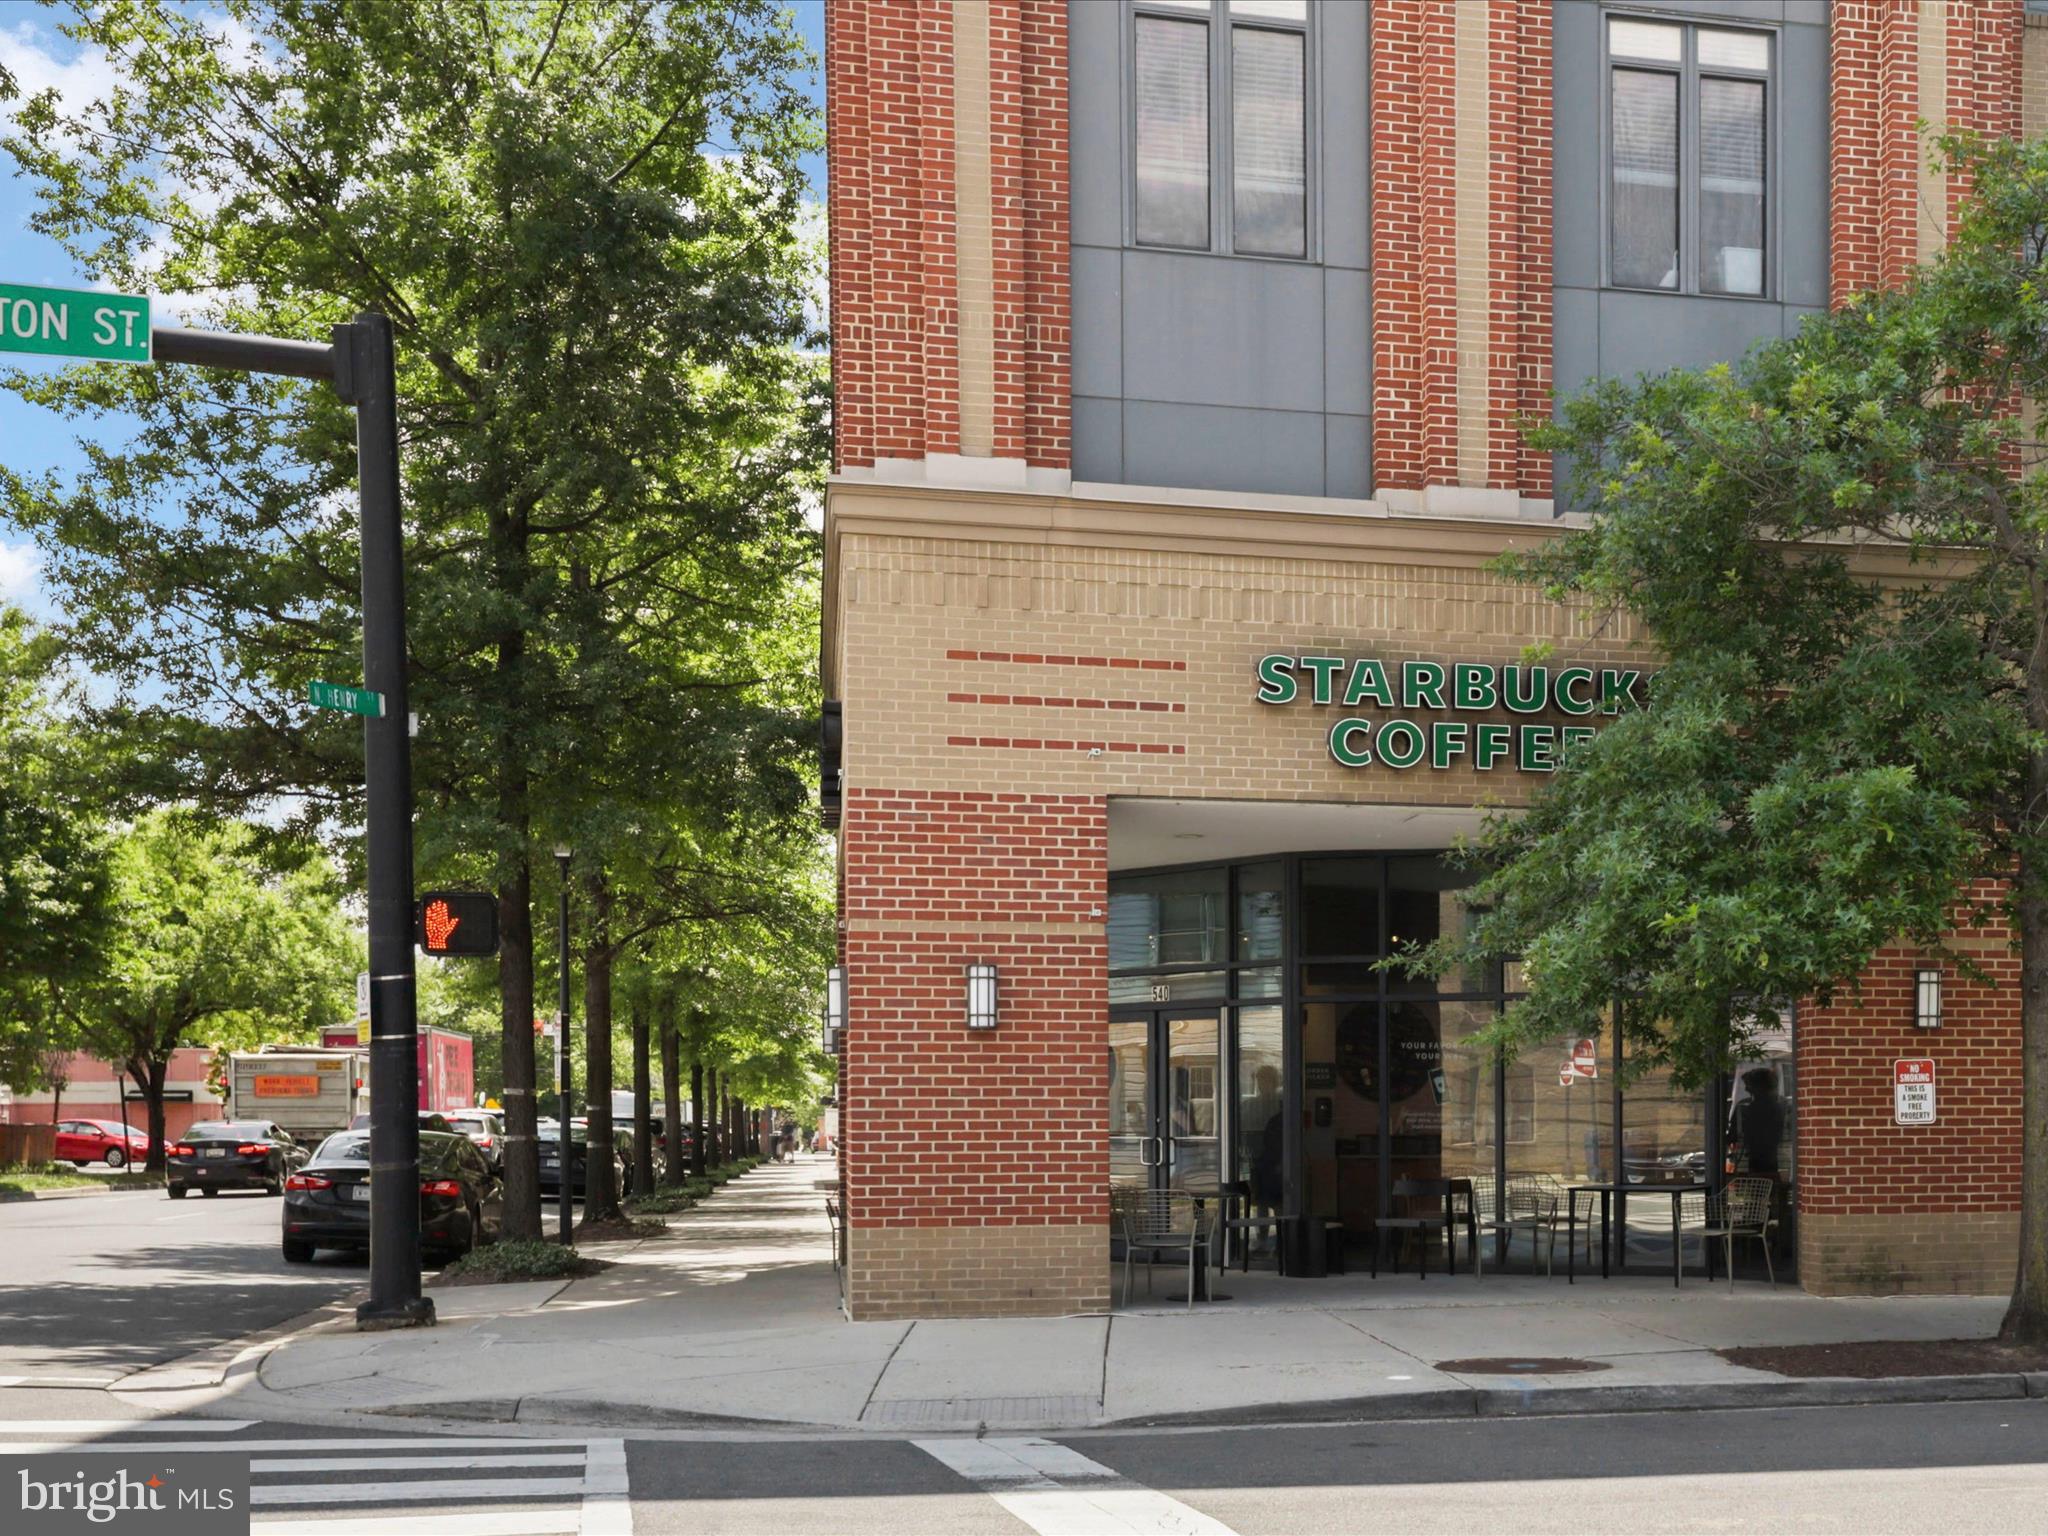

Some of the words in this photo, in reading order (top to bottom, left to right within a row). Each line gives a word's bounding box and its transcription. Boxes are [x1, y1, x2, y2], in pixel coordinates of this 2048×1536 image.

[93, 307, 148, 348] ST.
[1256, 654, 1657, 716] STARBUCK
[327, 688, 358, 709] HENRY
[1152, 985, 1169, 1001] 540
[1400, 1041, 1426, 1050] YOUR
[1415, 1052, 1441, 1060] YOUR
[1909, 1064, 1920, 1073] NO
[1900, 1073, 1930, 1082] SMOKING
